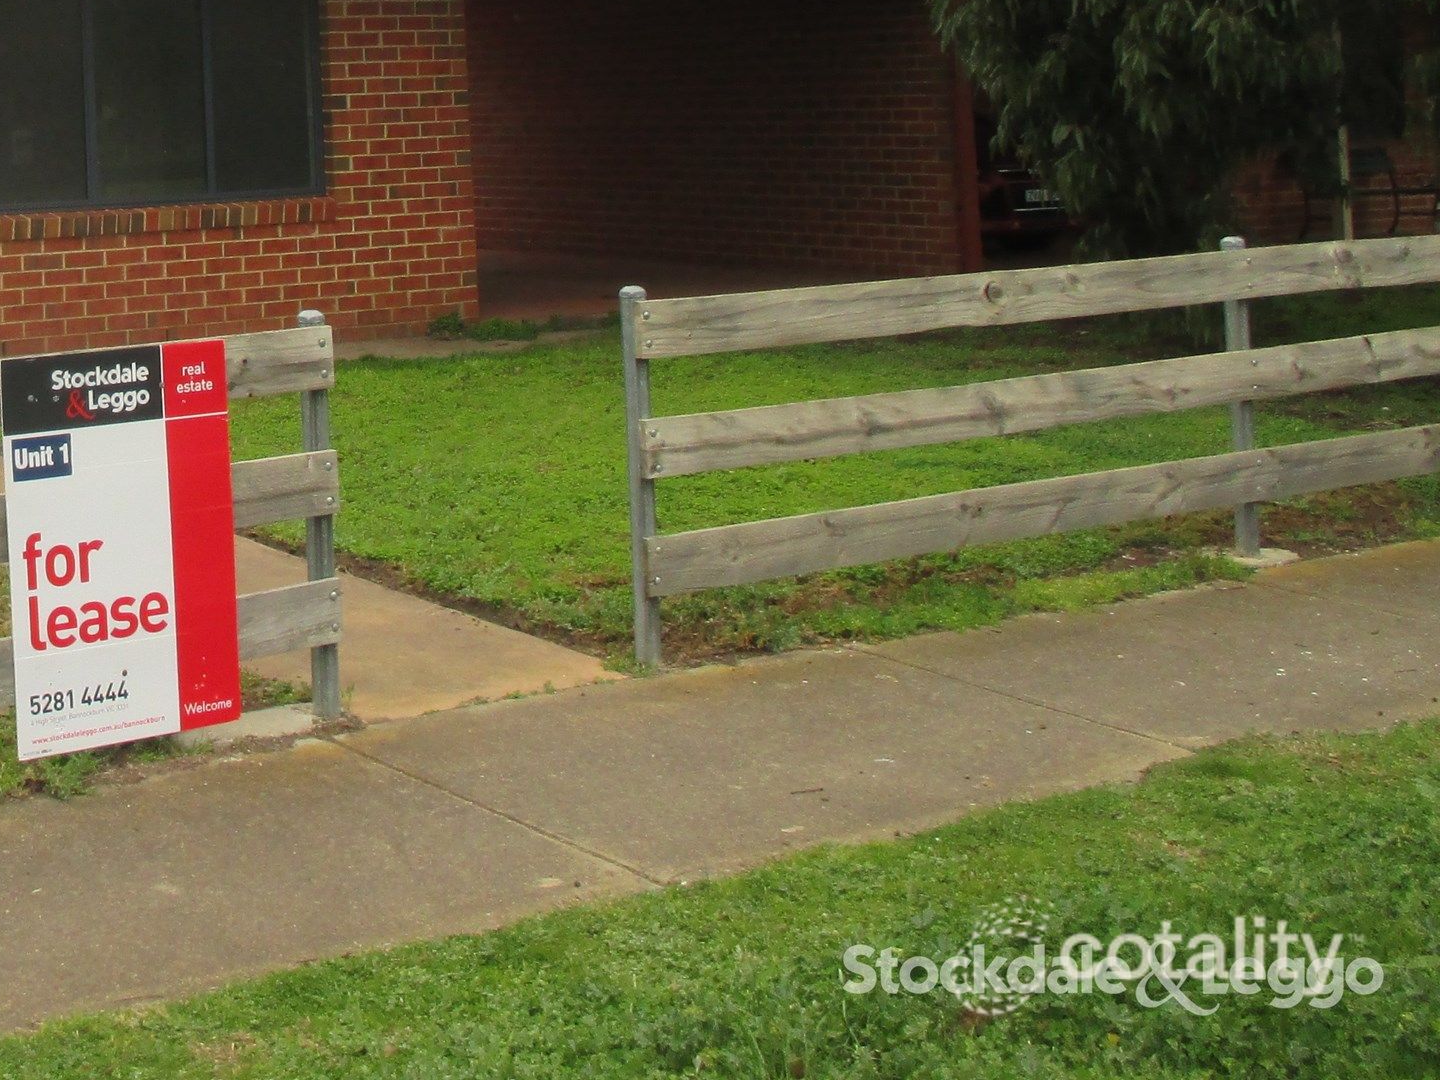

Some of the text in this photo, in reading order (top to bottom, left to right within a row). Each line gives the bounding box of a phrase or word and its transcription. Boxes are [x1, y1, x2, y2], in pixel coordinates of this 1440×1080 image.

[51, 362, 149, 390] Stockdale
[182, 361, 205, 376] real
[176, 379, 213, 394] estate
[66, 389, 150, 420] & Leggo
[14, 442, 70, 470] Unit 1
[23, 532, 104, 591] for
[29, 591, 169, 651] lease
[30, 680, 129, 716] 5281 4444
[184, 700, 233, 716] Welcome
[32, 715, 166, 744] www.stockdaleleggo.com.au/bannockburn
